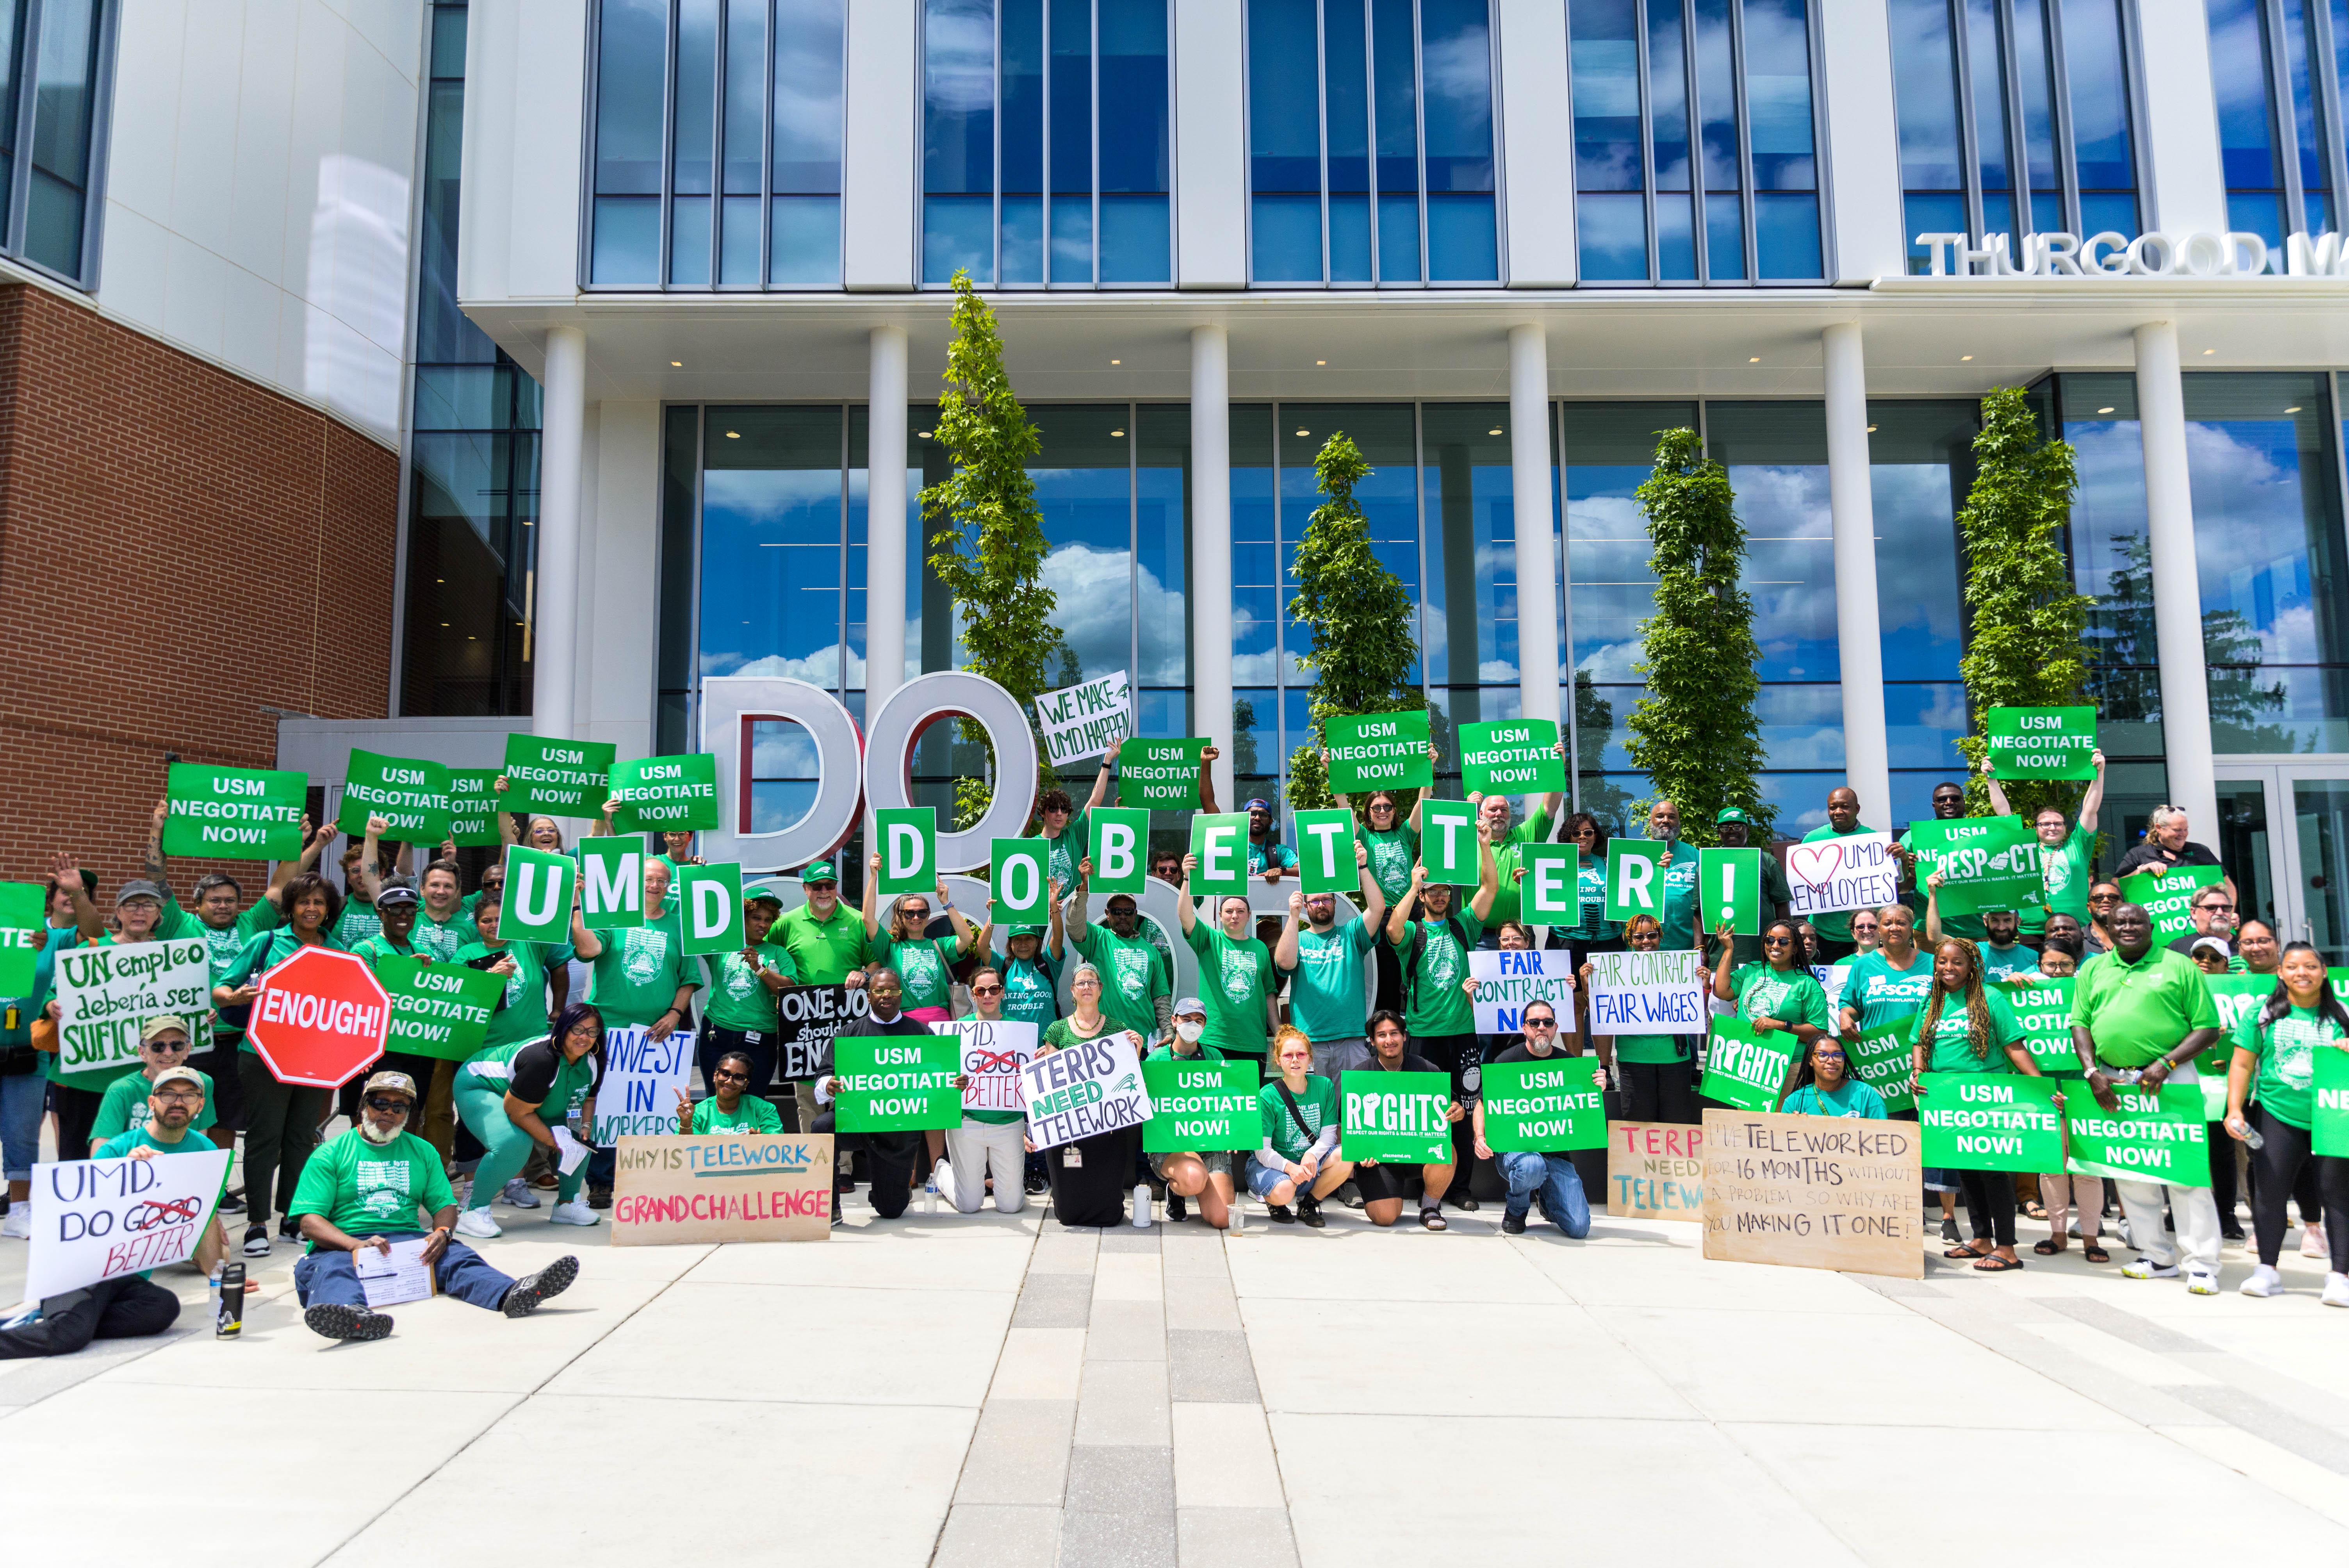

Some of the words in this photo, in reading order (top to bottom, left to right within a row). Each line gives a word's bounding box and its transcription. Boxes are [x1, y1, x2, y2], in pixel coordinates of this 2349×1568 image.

[1915, 231, 2267, 276] THURGOOD
[1039, 692, 1075, 725] WE
[1075, 680, 1117, 715] MAKE
[1046, 727, 1085, 759] UMD
[1083, 708, 1129, 752] HAPPEN
[1357, 722, 1397, 738] USM
[2020, 716, 2062, 729] USM
[1490, 728, 1530, 743] USM
[1991, 736, 2093, 748] NEGOTIATE
[542, 748, 584, 764] USM
[1148, 747, 1184, 760] USM
[1331, 741, 1427, 761] NEGOTIATE
[1464, 747, 1560, 766] NEGOTIATE
[2016, 755, 2066, 767] NOW!
[382, 767, 425, 785] USM
[506, 764, 608, 787] NEGOTIATE
[640, 764, 681, 780] USM
[700, 670, 1040, 875] DO
[1121, 766, 1199, 779] NEGOTIAT
[1356, 763, 1404, 779] NOW!
[1490, 768, 1537, 782] NOW!
[213, 778, 265, 796] USM
[346, 782, 448, 809] NEGOTIATE
[530, 788, 582, 805] NOW!
[610, 784, 713, 800] NEGOTIATE
[1144, 785, 1187, 798] NOW!
[170, 799, 300, 822] NEGOTIATE
[638, 805, 689, 820] NOW!
[202, 825, 267, 845] NOW!
[1432, 814, 1468, 870] T
[1945, 827, 1987, 841] USM
[888, 823, 924, 879] D
[1099, 823, 1135, 879] B
[1204, 826, 1236, 880] E
[1306, 822, 1345, 878] T
[1843, 841, 1884, 869] UMD
[585, 852, 639, 913] M
[1001, 853, 1039, 910] O
[1535, 858, 1566, 911] E
[1617, 853, 1654, 909] R
[1721, 863, 1734, 920] !
[1793, 873, 1895, 911] EMPLOYEES
[2153, 876, 2197, 893] USM
[515, 862, 563, 926] U
[692, 880, 731, 938] D
[1299, 946, 1343, 959] AFSCME
[1499, 951, 1543, 975] FAIR
[62, 950, 114, 988] UN
[116, 943, 205, 982] empleo
[626, 971, 654, 982] EMPLOYEES
[1588, 953, 1625, 987] FAIR
[1630, 952, 1699, 986] CONTRACT
[414, 971, 464, 994] USM
[1241, 971, 1251, 986] COUNTY
[75, 982, 159, 1020] debería
[168, 987, 204, 1006] ser
[1226, 990, 1249, 1000] EMPLOYEES
[1472, 978, 1566, 1003] CONTRACT
[2011, 989, 2063, 1007] USM
[262, 987, 381, 1038] ENOUGH!
[388, 992, 490, 1024] EGOTIATE
[782, 988, 835, 1021] ONE
[1595, 993, 1638, 1023] FAIR
[1642, 991, 1698, 1023] WAGES
[390, 1019, 451, 1042] NOW!
[797, 1019, 841, 1041] should
[607, 1031, 691, 1075] INVEST
[875, 1048, 921, 1065] USM
[1855, 1033, 1899, 1057] USM
[965, 1049, 1029, 1074] GOOD
[1025, 1038, 1116, 1094] TERPS
[839, 1072, 957, 1091] NEGOTIATE
[1178, 1072, 1223, 1089] USM
[1520, 1070, 1564, 1089] USM
[1708, 1068, 1724, 1076] RESPECT
[1732, 1075, 1745, 1083] RIGHTS
[627, 1079, 656, 1112] IN
[966, 1074, 1026, 1108] BETTER
[1032, 1080, 1103, 1119] NEED
[1960, 1084, 2013, 1104] USM
[870, 1098, 928, 1115] NOW!
[1150, 1095, 1257, 1113] NEGOTIATE
[1487, 1092, 1600, 1115] NEGOTIATE
[590, 1115, 679, 1145] WORKERS
[1033, 1094, 1146, 1146] TELEWORK
[1174, 1120, 1230, 1136] NOW!
[1518, 1119, 1574, 1138] NOW!
[1923, 1110, 2056, 1130] NEGOTIATE
[2071, 1118, 2204, 1142] NEGOTIATE
[1619, 1126, 1702, 1157] TERP
[1708, 1124, 1741, 1148] I'VE
[1743, 1124, 1908, 1157] TELEWORKED
[1956, 1135, 2023, 1155] NOW!
[619, 1148, 658, 1170] WHY
[664, 1147, 683, 1169] IS
[686, 1144, 812, 1170] TELEWORK
[814, 1147, 828, 1166] A
[1644, 1159, 1701, 1177] NEED
[2105, 1146, 2171, 1168] NOW!
[1708, 1157, 1734, 1175] FOR
[1737, 1158, 1755, 1180] 16
[1761, 1156, 1843, 1185] MONTHS
[1848, 1166, 1918, 1181] WITHOUT
[691, 1189, 831, 1221] CHALLENGE
[1711, 1187, 1721, 1202] A
[1729, 1185, 1791, 1204] PROBLEM
[1805, 1190, 1830, 1206] SO
[1836, 1191, 1875, 1209] WHY
[1882, 1194, 1918, 1210] ARE
[60, 1210, 114, 1242] DO
[124, 1196, 202, 1232] GOOD
[1704, 1214, 1731, 1232] YOU
[1737, 1211, 1811, 1237] MAKING
[1822, 1215, 1846, 1236] IT
[1852, 1215, 1919, 1239] ONE?
[102, 1223, 194, 1277] BETTER
